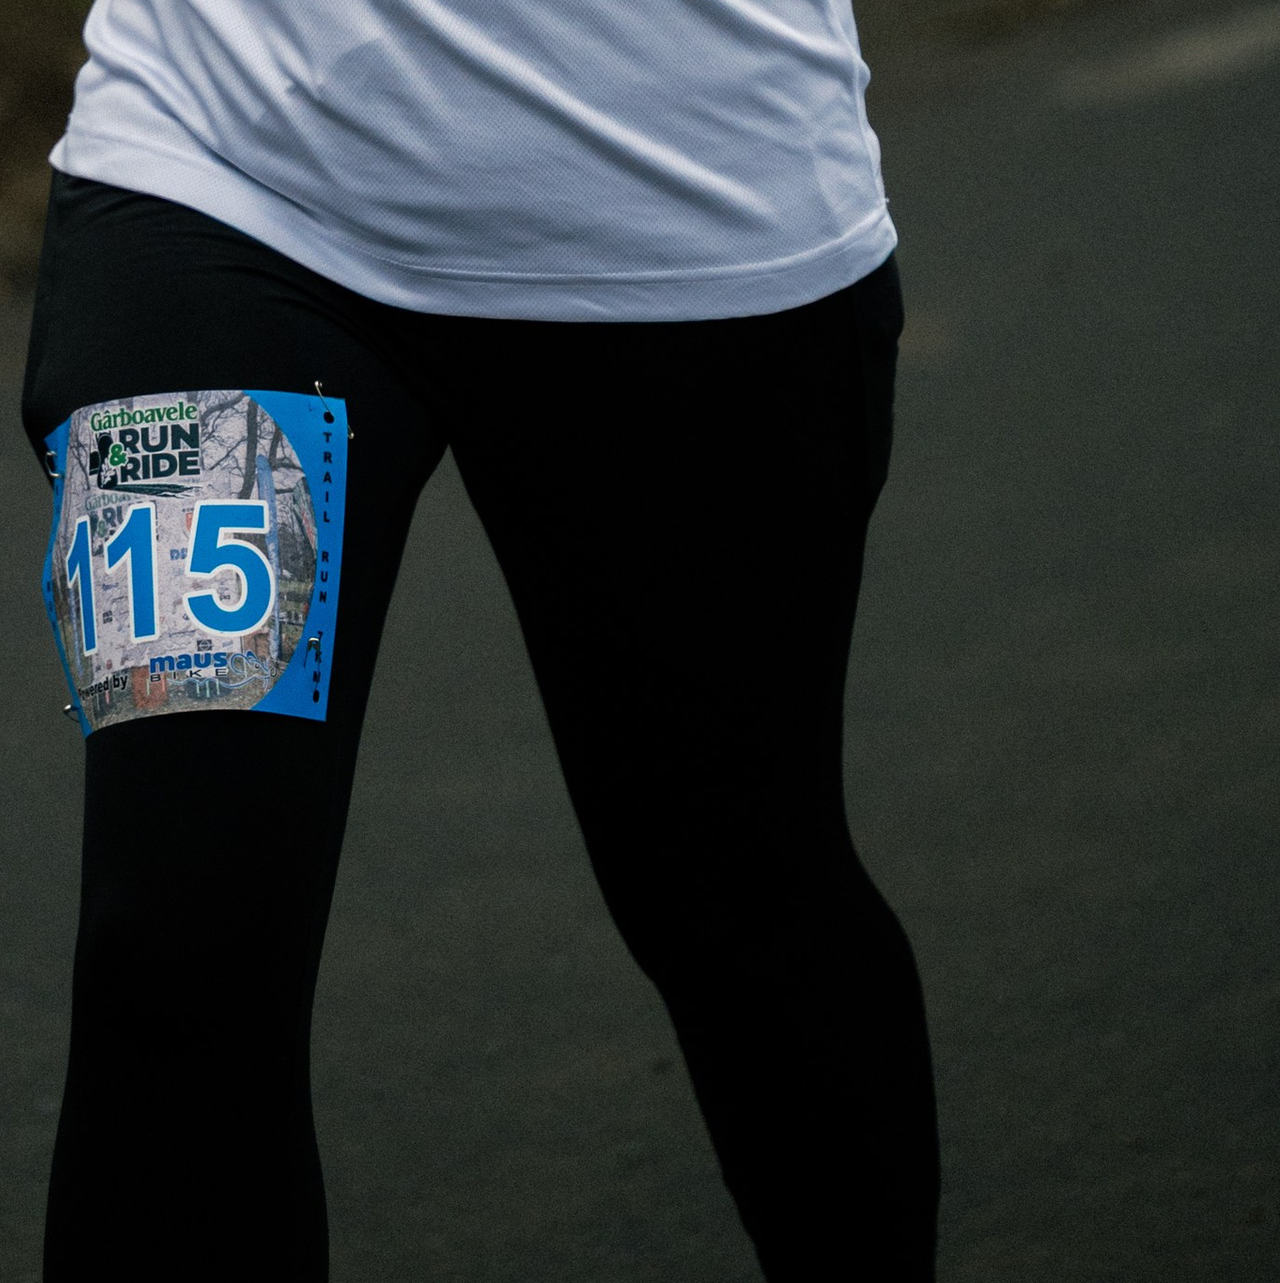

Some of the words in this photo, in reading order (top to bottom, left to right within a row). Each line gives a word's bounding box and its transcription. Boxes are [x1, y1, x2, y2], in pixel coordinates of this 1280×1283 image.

[90, 401, 198, 432] Gârboavele
[118, 423, 200, 454] RUN
[121, 451, 201, 483] RIDE
[323, 432, 333, 524] TRAIL
[66, 500, 273, 656] 115
[319, 550, 329, 603] RUN
[150, 651, 228, 673] maus
[150, 668, 228, 682] BIKE
[113, 674, 128, 690] by
